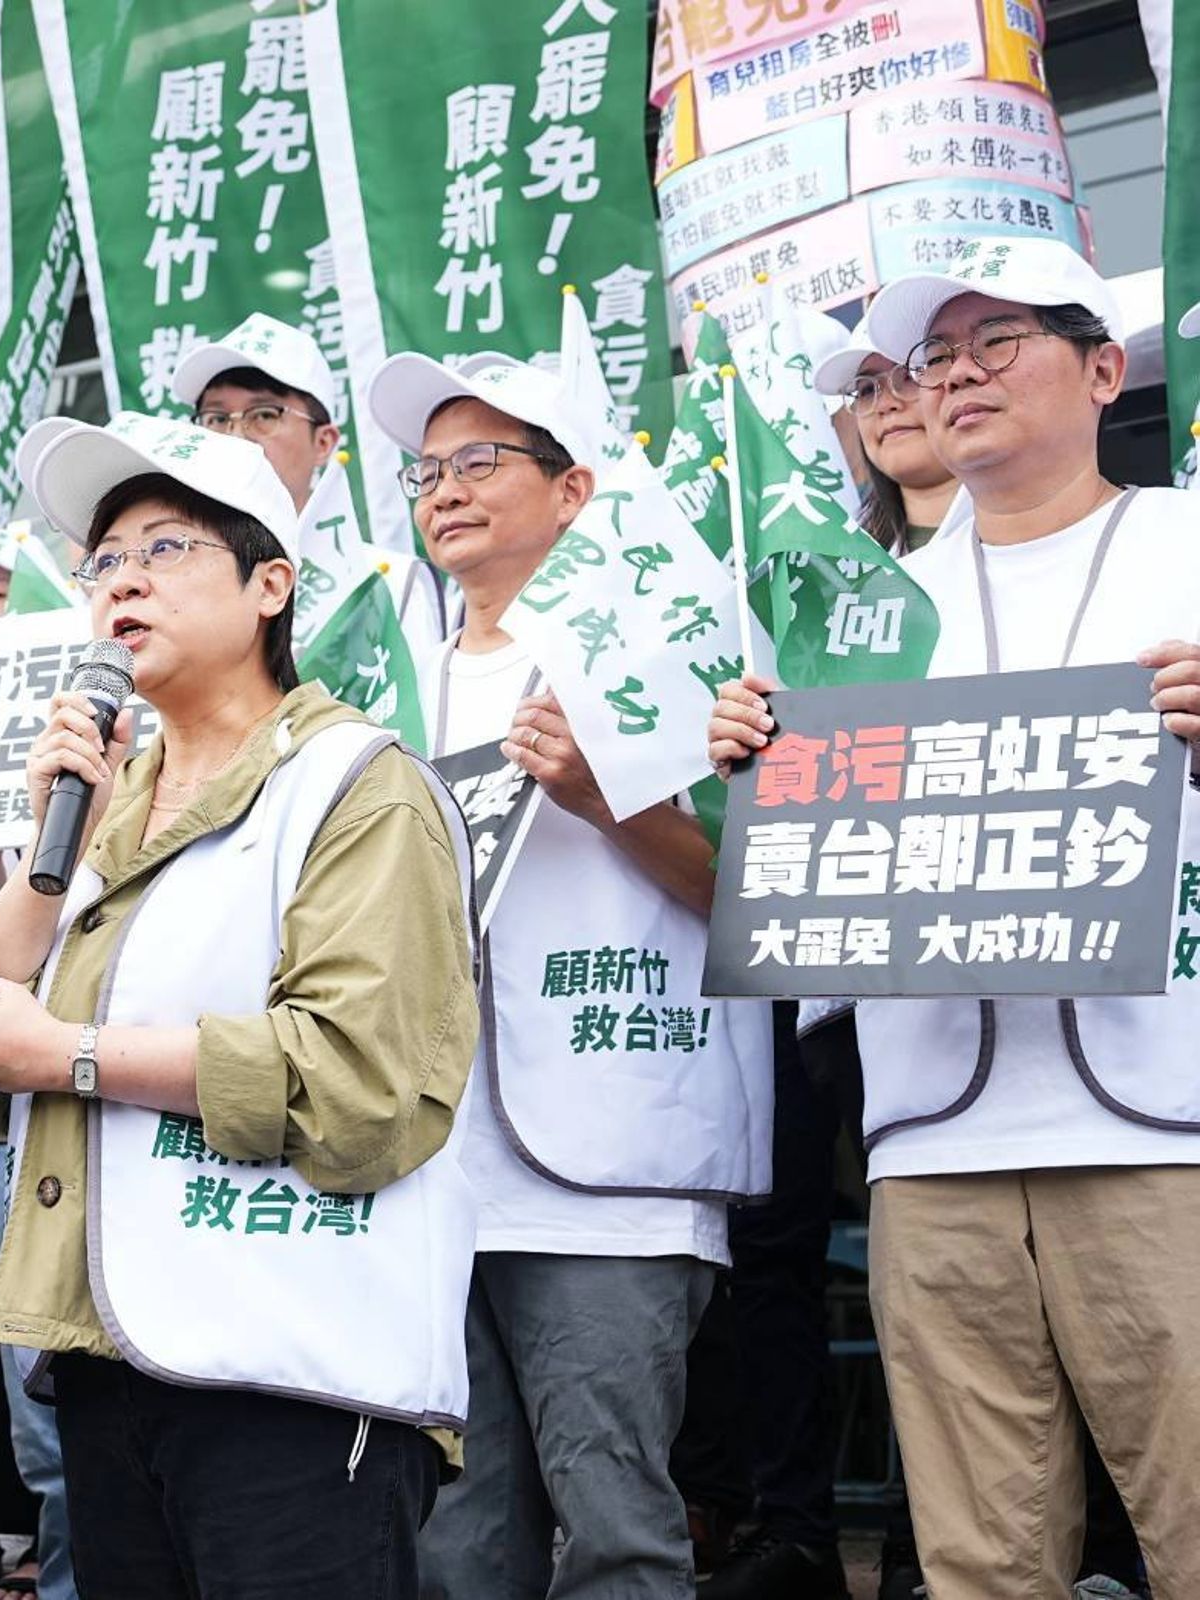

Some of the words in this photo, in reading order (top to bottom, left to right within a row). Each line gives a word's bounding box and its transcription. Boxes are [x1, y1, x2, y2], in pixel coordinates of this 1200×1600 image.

[706, 9, 901, 99] 育兒租房全被刪
[143, 60, 226, 307] 顧新竹
[434, 83, 516, 334] 顧新竹
[755, 708, 1161, 807] 貪污高虹安
[739, 805, 1153, 899] 賣台鄭正鈐
[541, 945, 669, 998] 顧新竹
[747, 916, 892, 968] 大罷免
[569, 1002, 711, 1054] 救台灣!
[180, 1175, 376, 1236] 救台灣!
